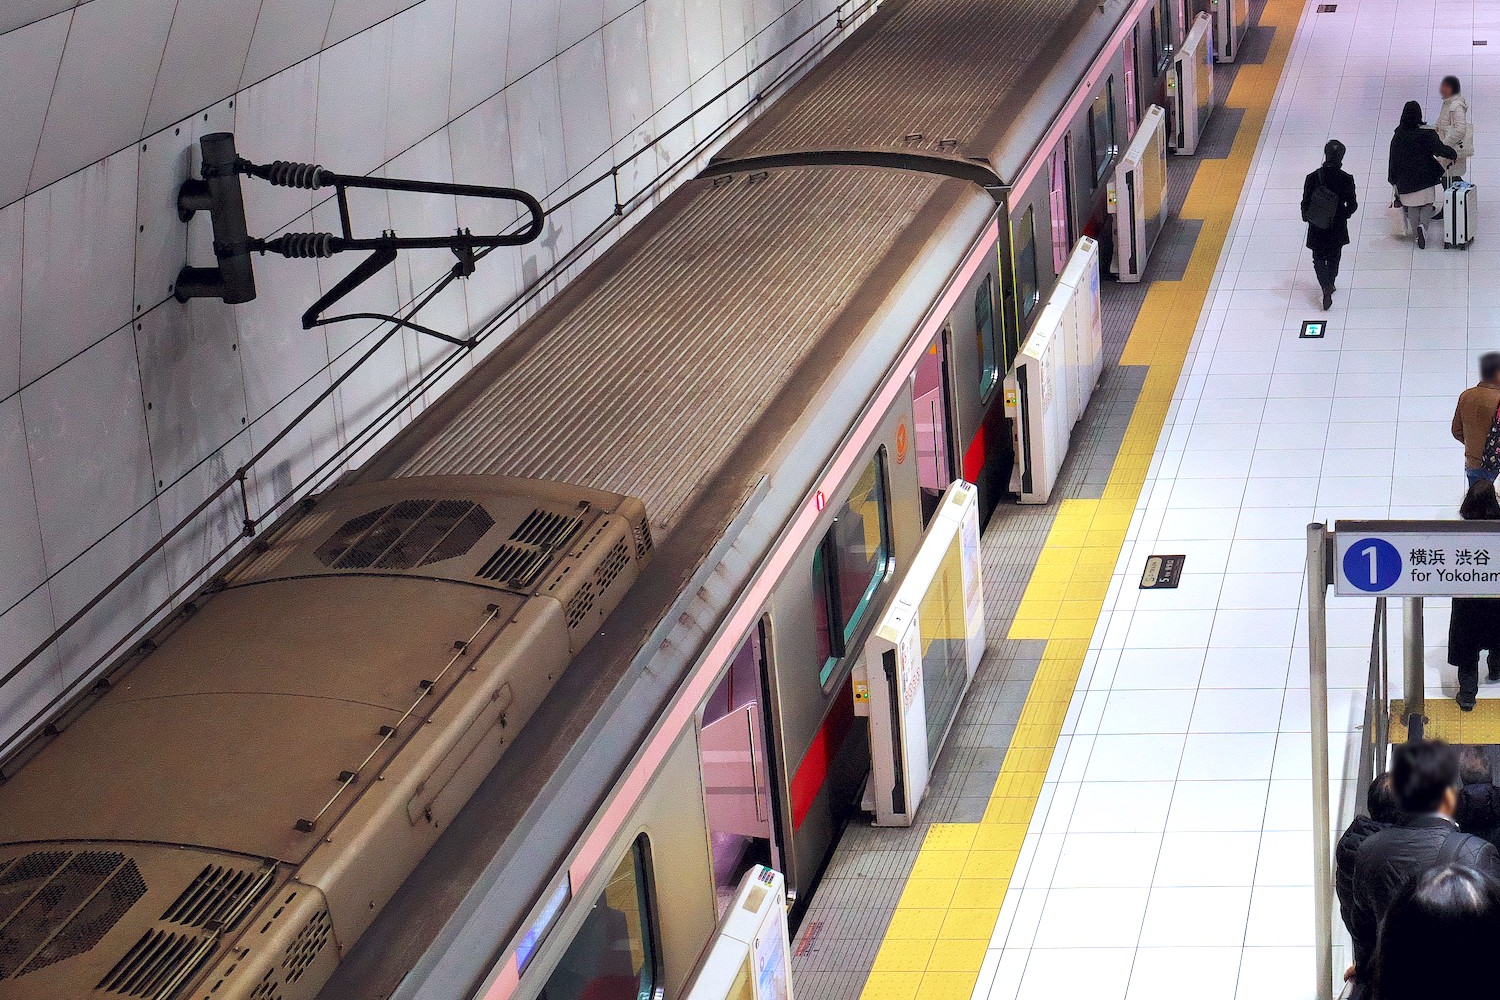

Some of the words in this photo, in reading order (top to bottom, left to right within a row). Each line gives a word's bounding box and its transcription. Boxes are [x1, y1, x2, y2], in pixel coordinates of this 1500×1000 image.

[1361, 545, 1379, 585] 1
[1410, 548, 1446, 566] 横浜
[1455, 548, 1491, 566] 渋谷
[1410, 568, 1432, 582] for
